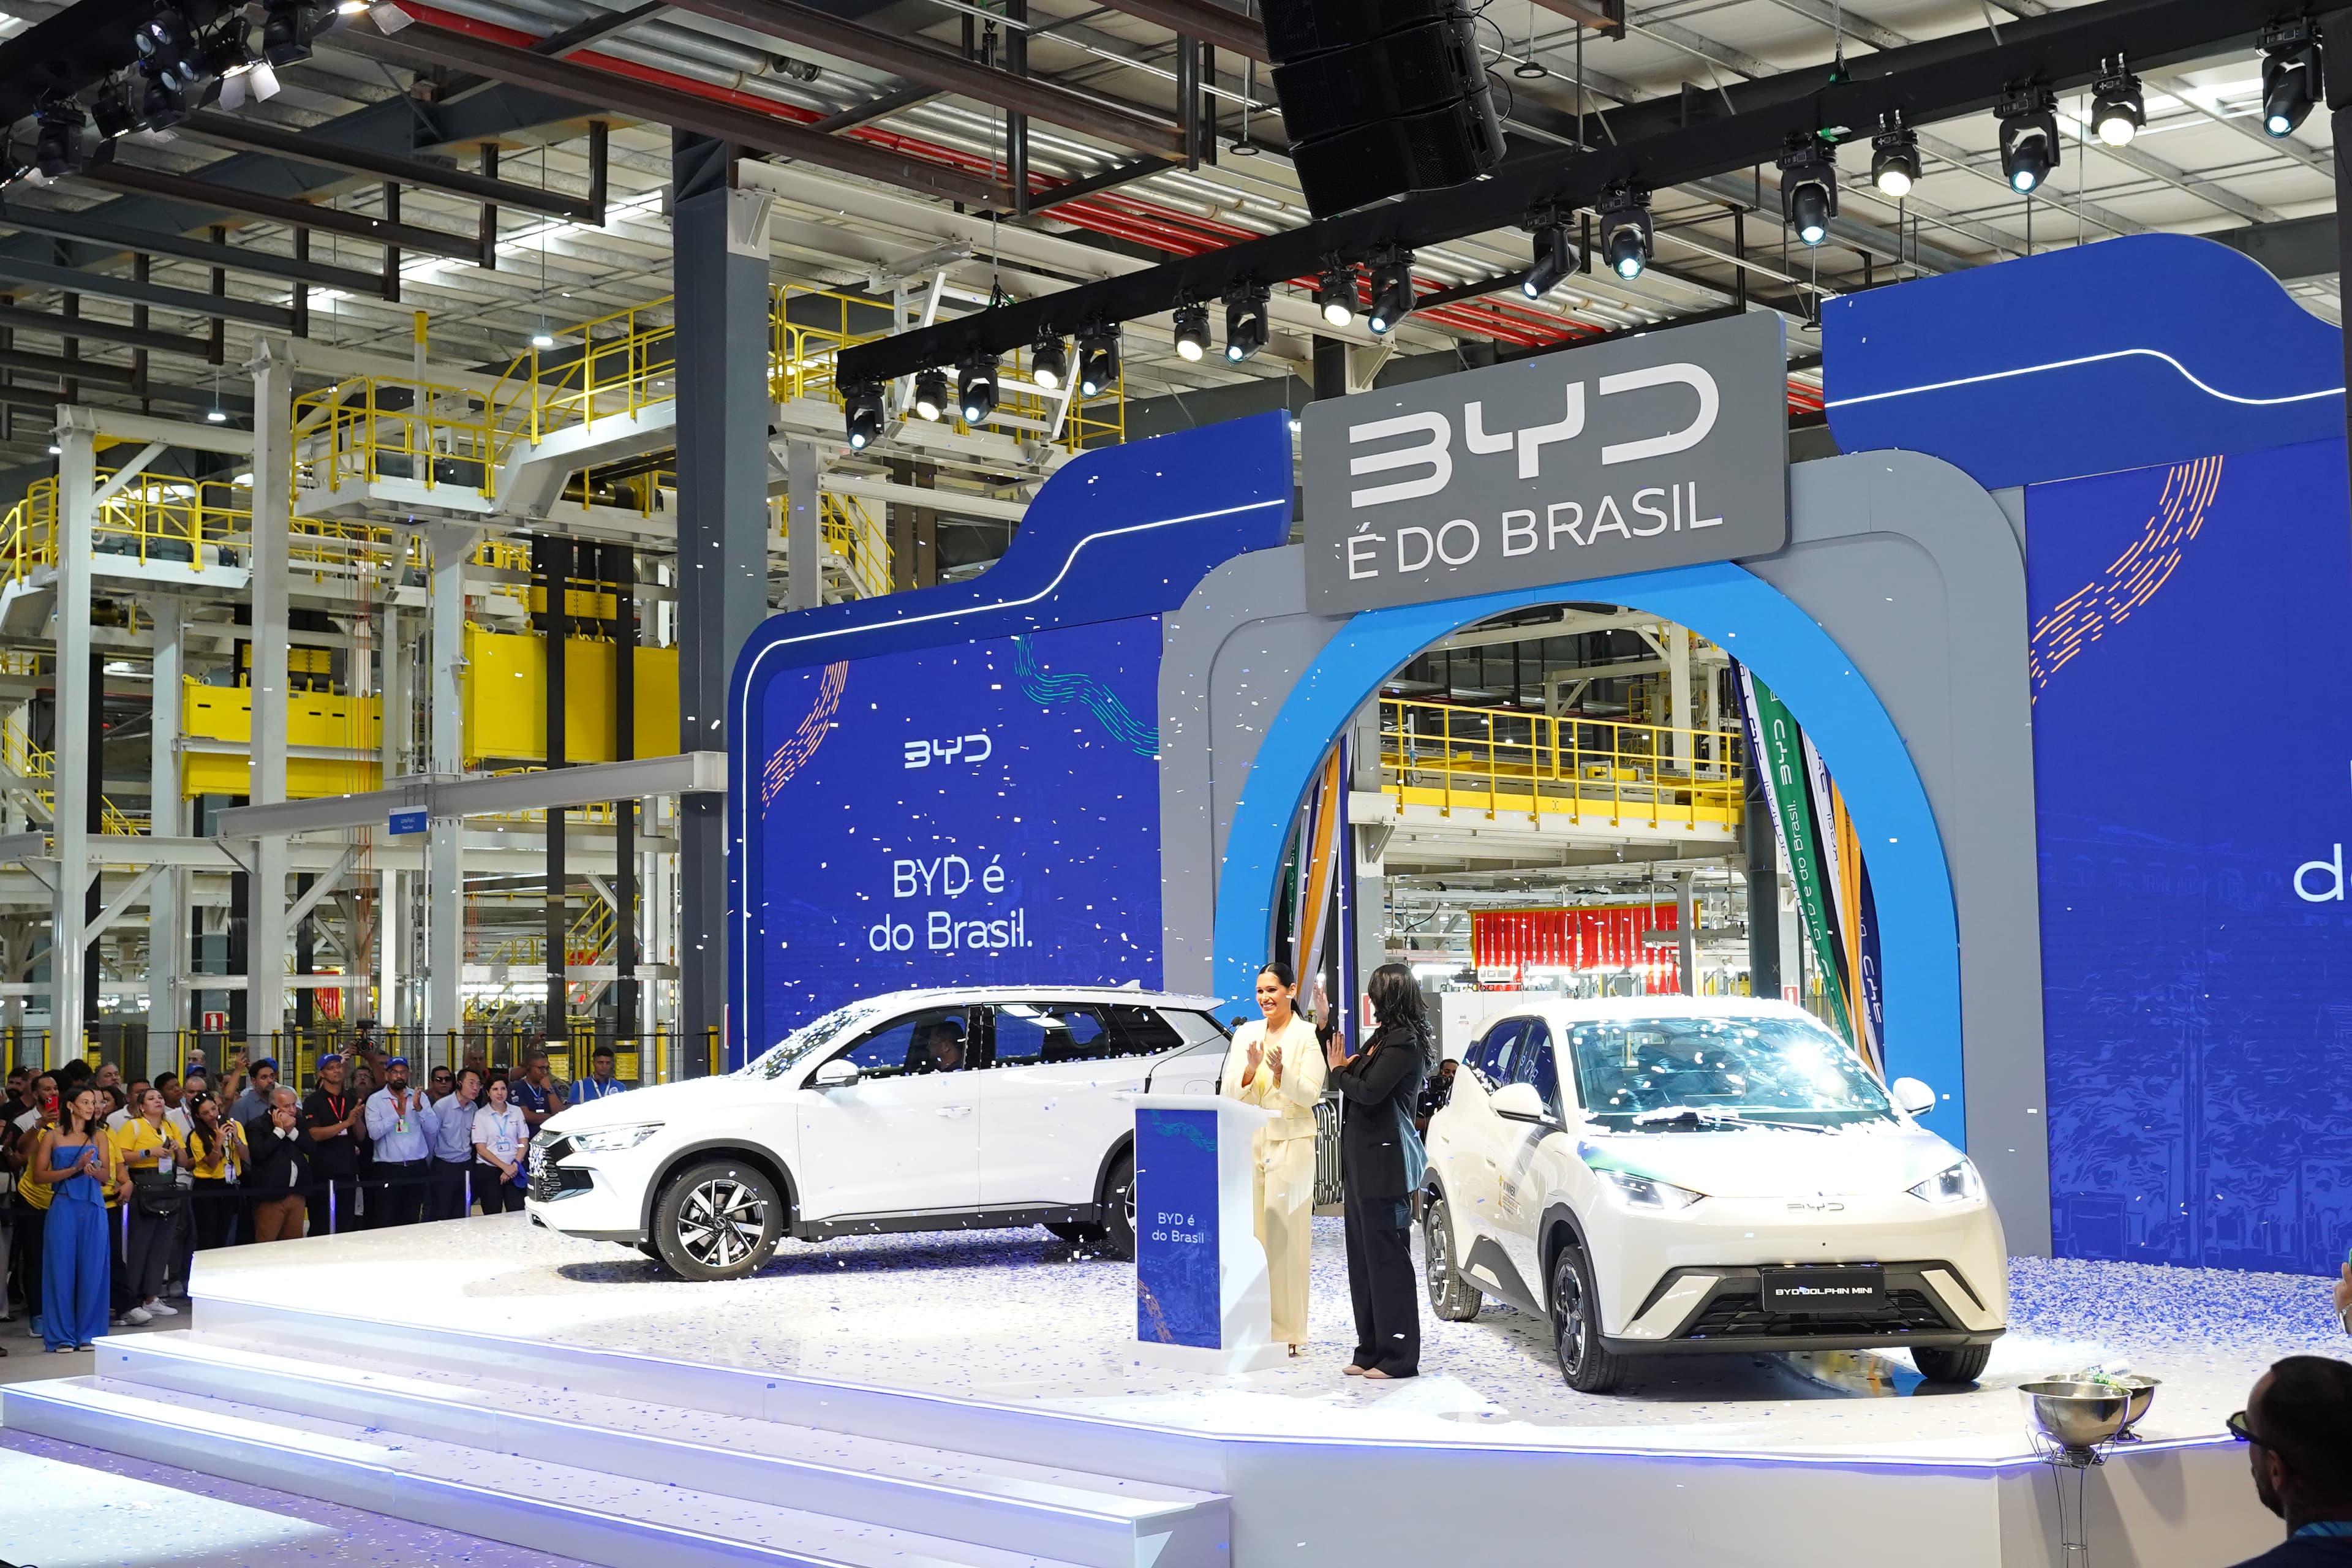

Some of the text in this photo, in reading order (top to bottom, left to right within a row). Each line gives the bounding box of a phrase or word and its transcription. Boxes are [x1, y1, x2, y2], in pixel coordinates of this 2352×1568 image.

[1349, 363, 1719, 508] BYD
[1397, 519, 1479, 573] DO
[1502, 481, 1723, 557] BRASIL
[905, 734, 992, 769] BYD
[1773, 718, 1793, 785] BYD
[894, 854, 1005, 898] BYD é
[2294, 843, 2352, 902] d
[869, 908, 1033, 951] do Brasil.
[1158, 1212, 1195, 1226] BYD é
[1787, 1203, 1844, 1213] BYD
[1152, 1229, 1204, 1243] do Brasil
